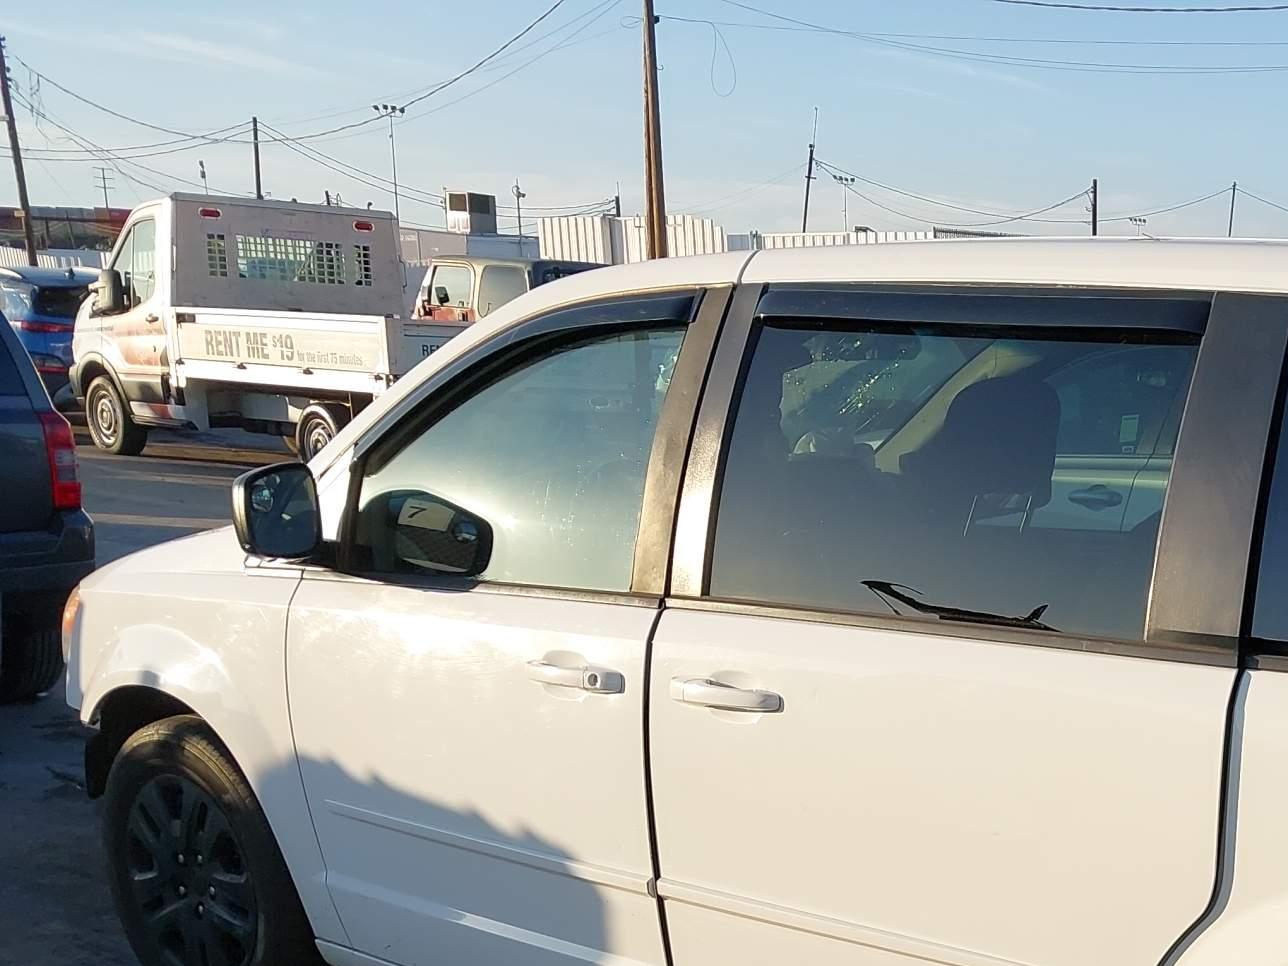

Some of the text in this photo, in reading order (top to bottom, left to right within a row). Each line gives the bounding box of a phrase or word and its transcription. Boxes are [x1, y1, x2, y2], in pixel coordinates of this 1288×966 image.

[205, 329, 241, 358] RENT
[245, 332, 270, 360] ME
[408, 505, 427, 519] 7
